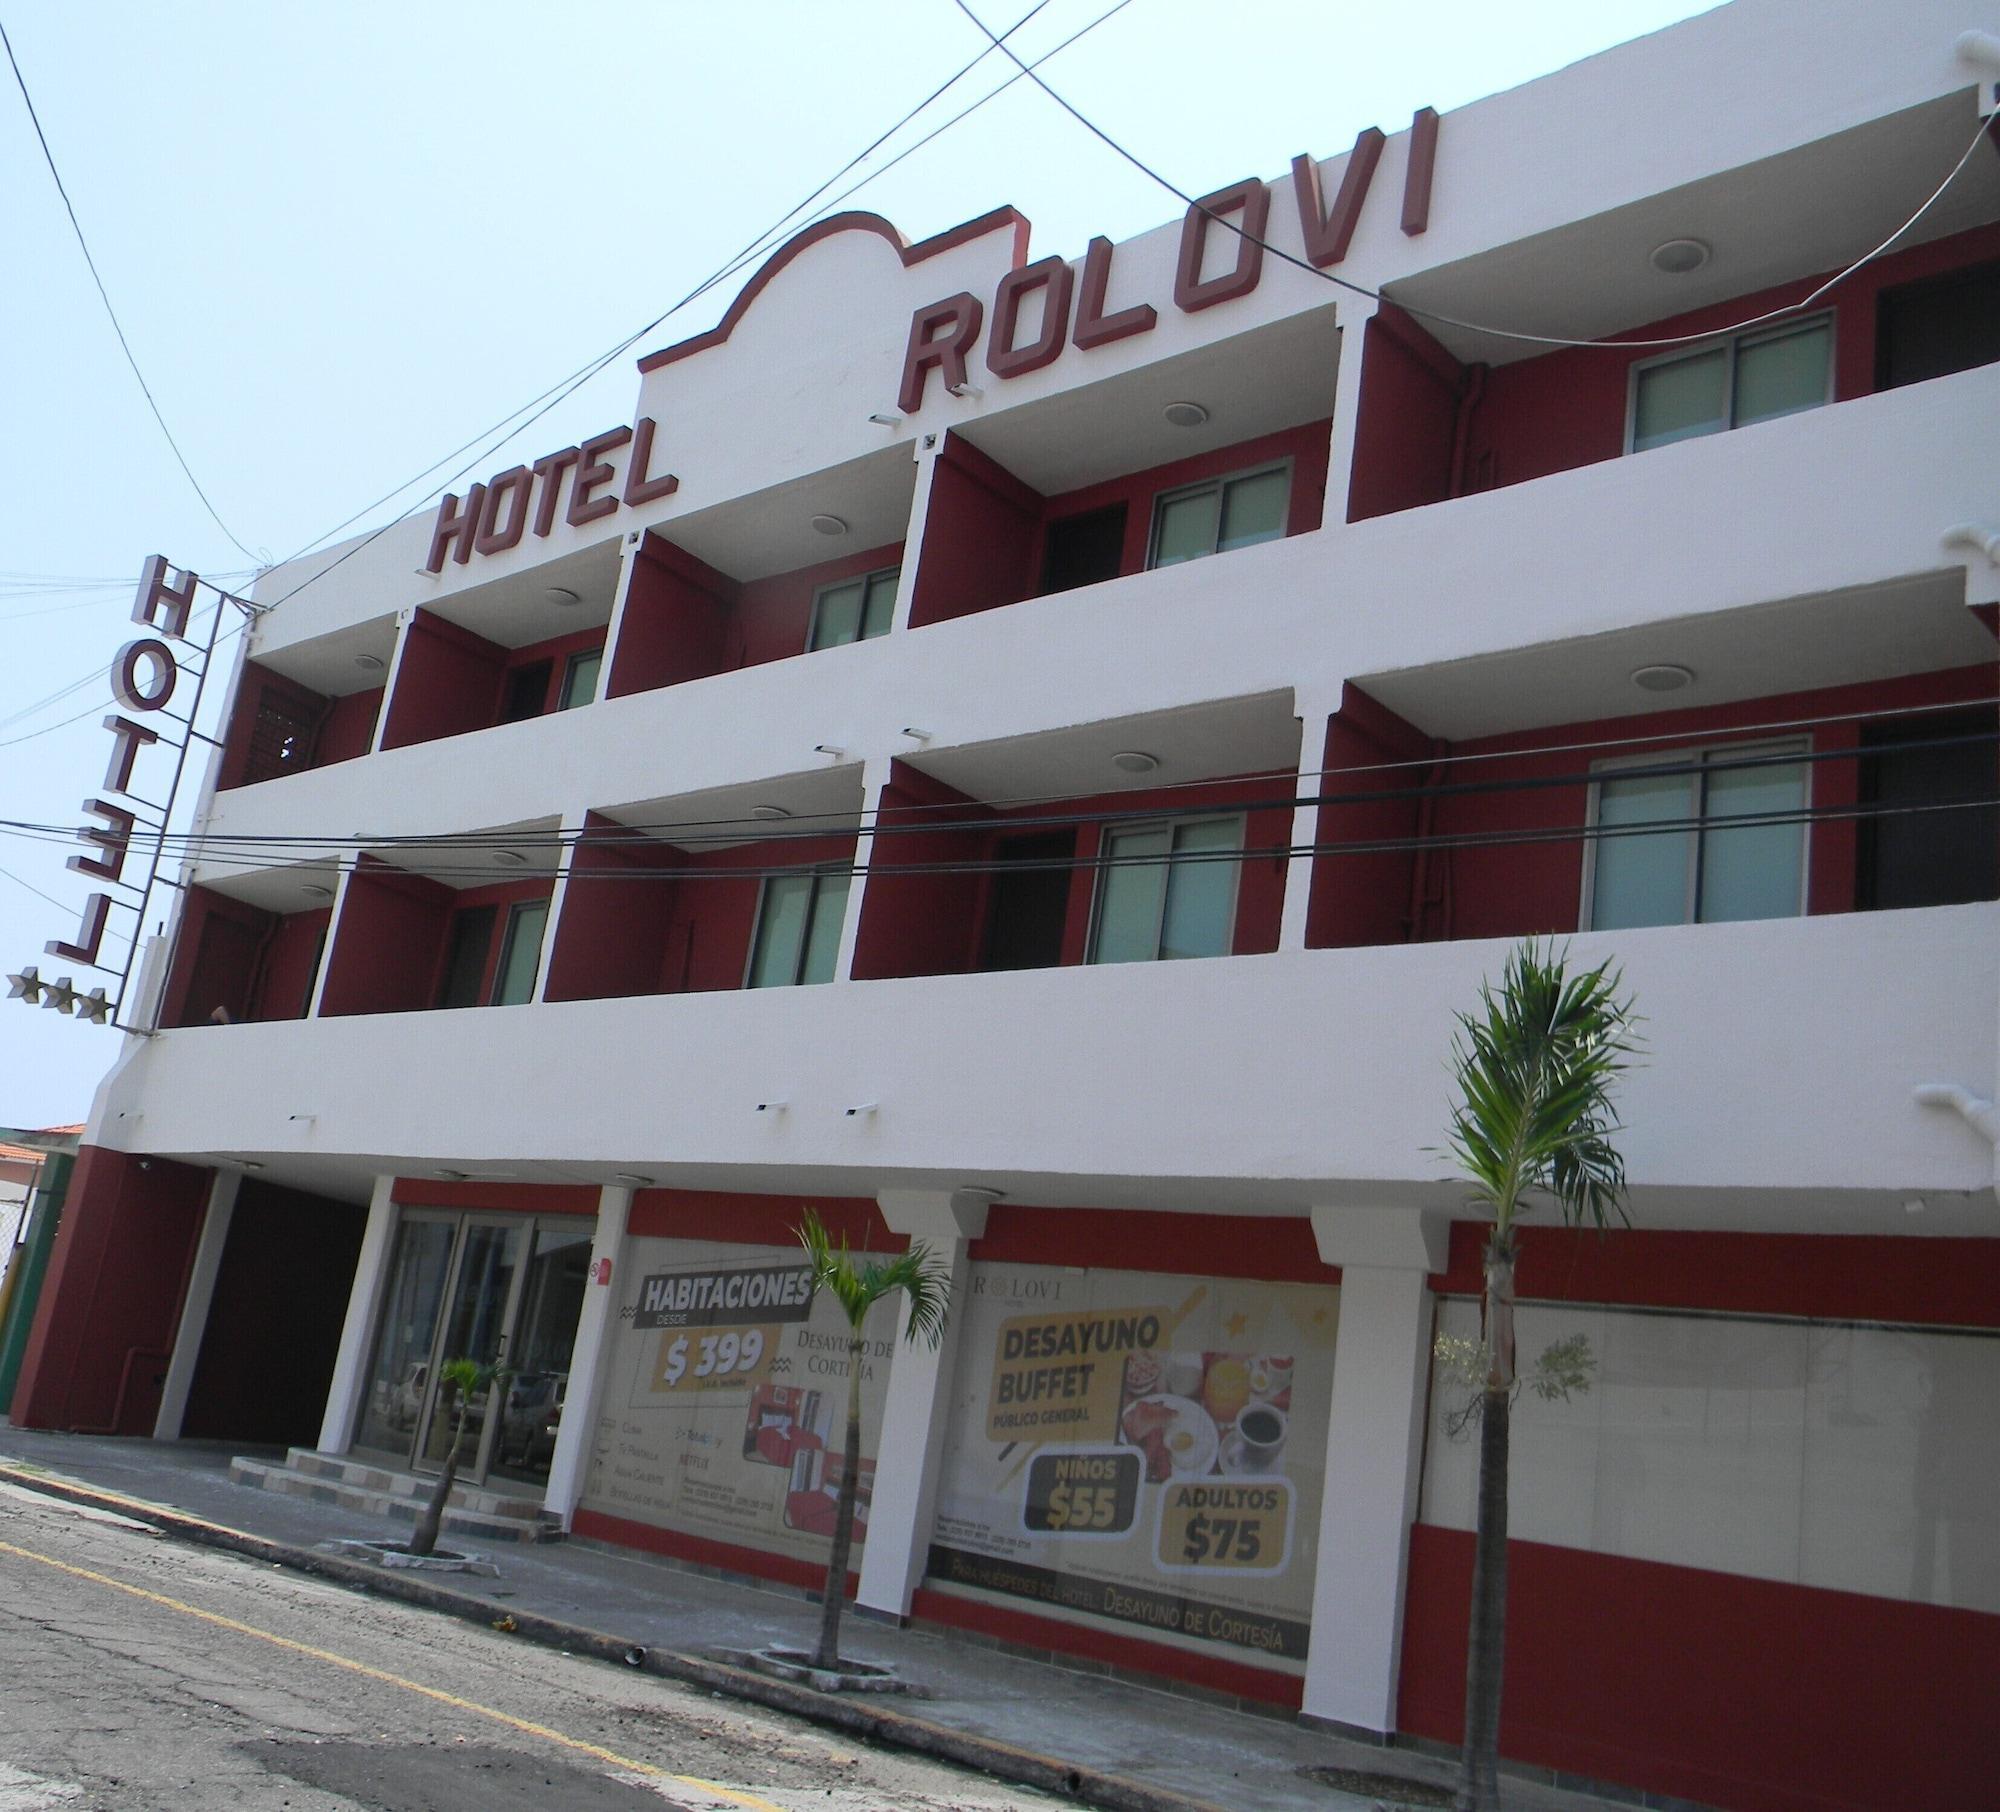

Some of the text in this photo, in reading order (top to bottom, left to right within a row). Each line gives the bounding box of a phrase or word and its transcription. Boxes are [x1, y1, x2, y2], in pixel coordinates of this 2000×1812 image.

[897, 106, 1440, 415] ROLOVI
[426, 417, 679, 574] HOTEL
[644, 1271, 813, 1313] HABITACIONES
[656, 1313, 688, 1326] DESDE
[1003, 1314, 1160, 1362] DESAYUNO
[797, 1329, 894, 1359] DESAYUO DE
[997, 1363, 1096, 1404] BUFFET
[1040, 1406, 1090, 1424] GENERAL
[1054, 1455, 1118, 1481] NIÑOS
[1046, 1483, 1117, 1531] $55
[1175, 1487, 1279, 1511] ADULTOS
[1182, 1514, 1262, 1564] $75
[1103, 1585, 1181, 1628] DESAYUNO
[1184, 1611, 1205, 1633] DE
[1208, 1608, 1284, 1651] CORTESÍA
